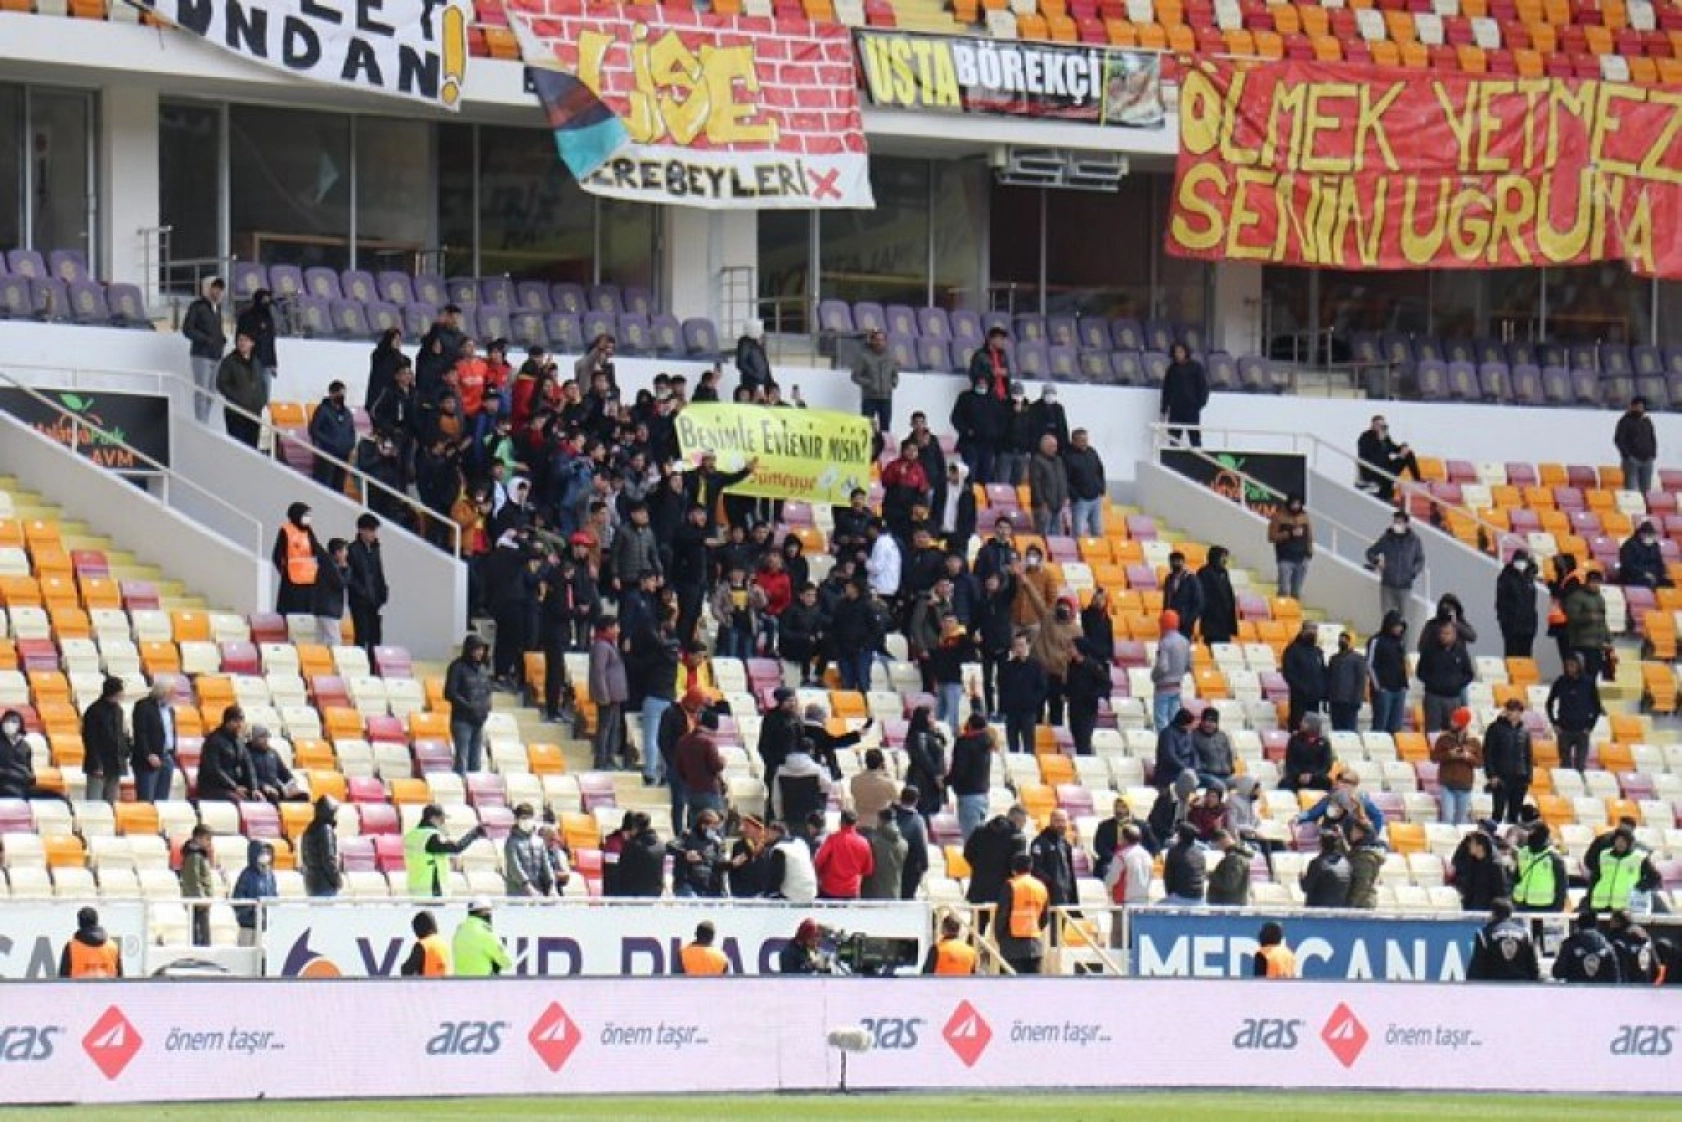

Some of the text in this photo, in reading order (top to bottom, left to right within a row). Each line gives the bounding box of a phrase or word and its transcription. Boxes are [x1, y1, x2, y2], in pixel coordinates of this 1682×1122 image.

[864, 35, 1101, 106] USTA BÖREKÇİ
[1180, 56, 1682, 183] ÖLMEK YETMEZ
[581, 157, 808, 198] EREBEYLERİ
[1171, 162, 1657, 273] SENİN UĞRUNA
[1138, 933, 1468, 982] MEDCANA
[164, 1026, 223, 1051] önem
[425, 1020, 506, 1056] aras
[600, 1022, 652, 1046] önem
[1010, 1020, 1058, 1043] önem
[1232, 1018, 1301, 1051] aras
[1385, 1023, 1432, 1046] önem
[1610, 1025, 1677, 1057] aras
